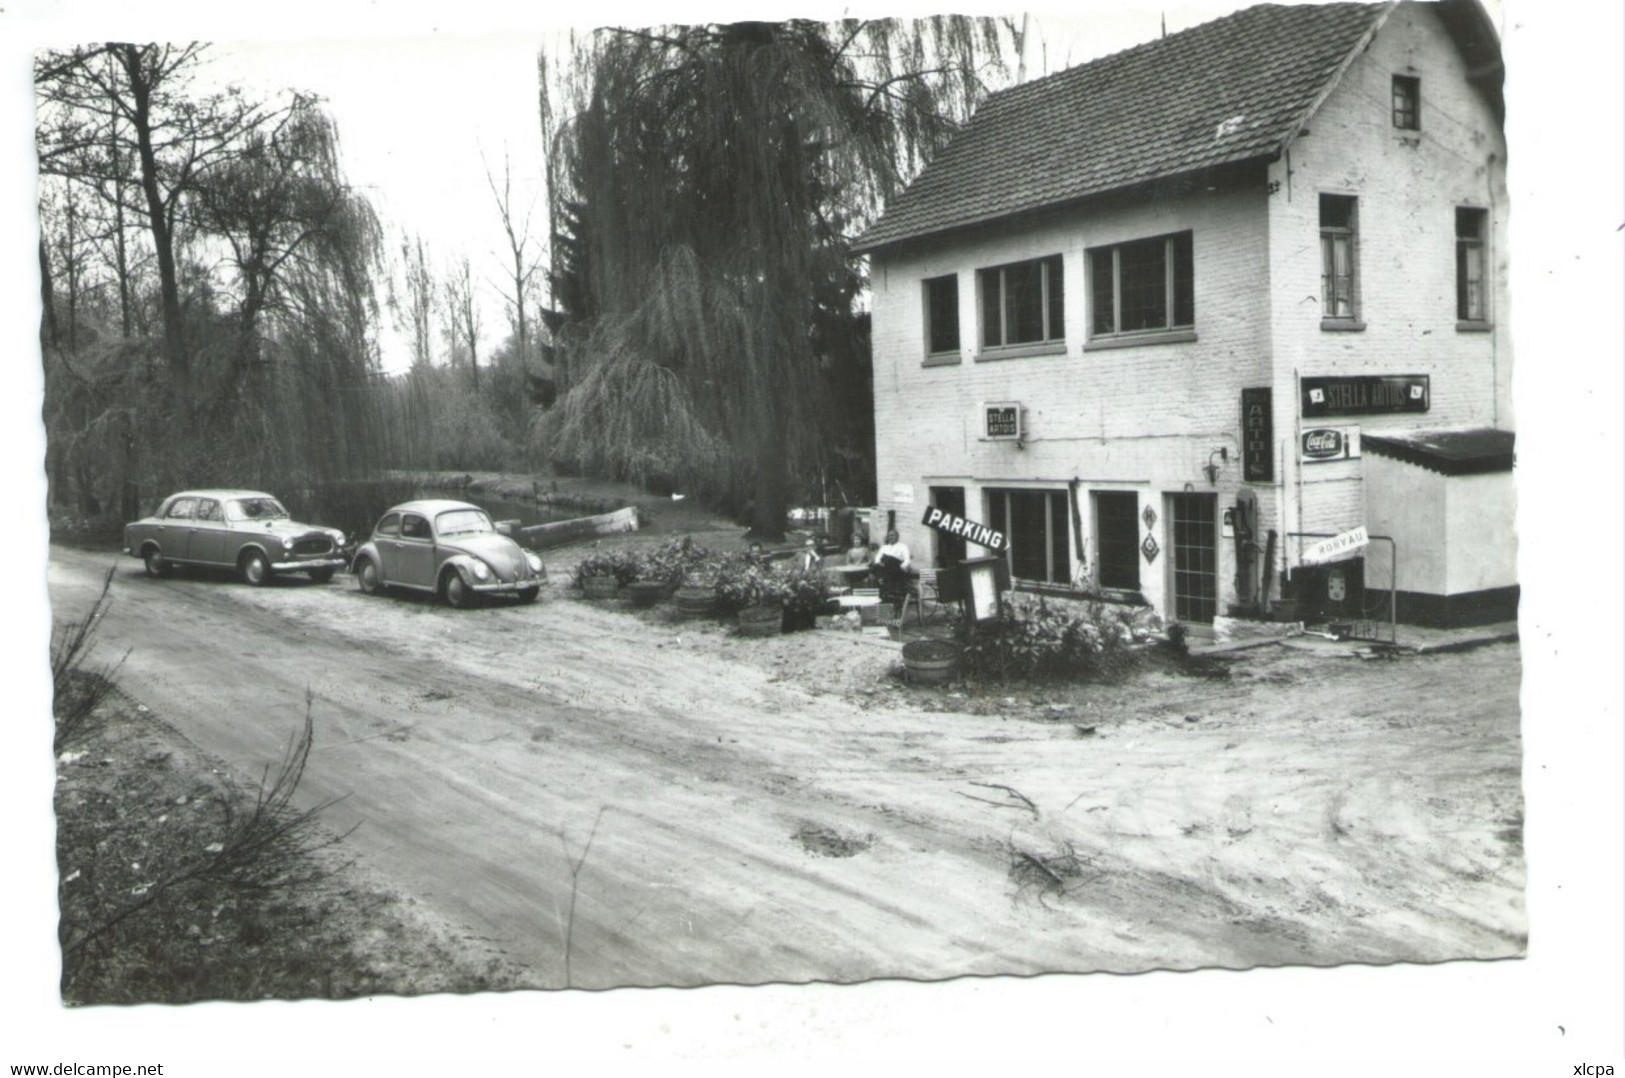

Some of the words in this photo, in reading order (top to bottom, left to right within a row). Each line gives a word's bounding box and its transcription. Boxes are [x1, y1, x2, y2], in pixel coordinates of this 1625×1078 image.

[1328, 384, 1367, 408] STELLA
[987, 413, 1015, 423] STELLA
[988, 424, 1015, 434] ARTOIS
[928, 508, 1003, 549] PARKING
